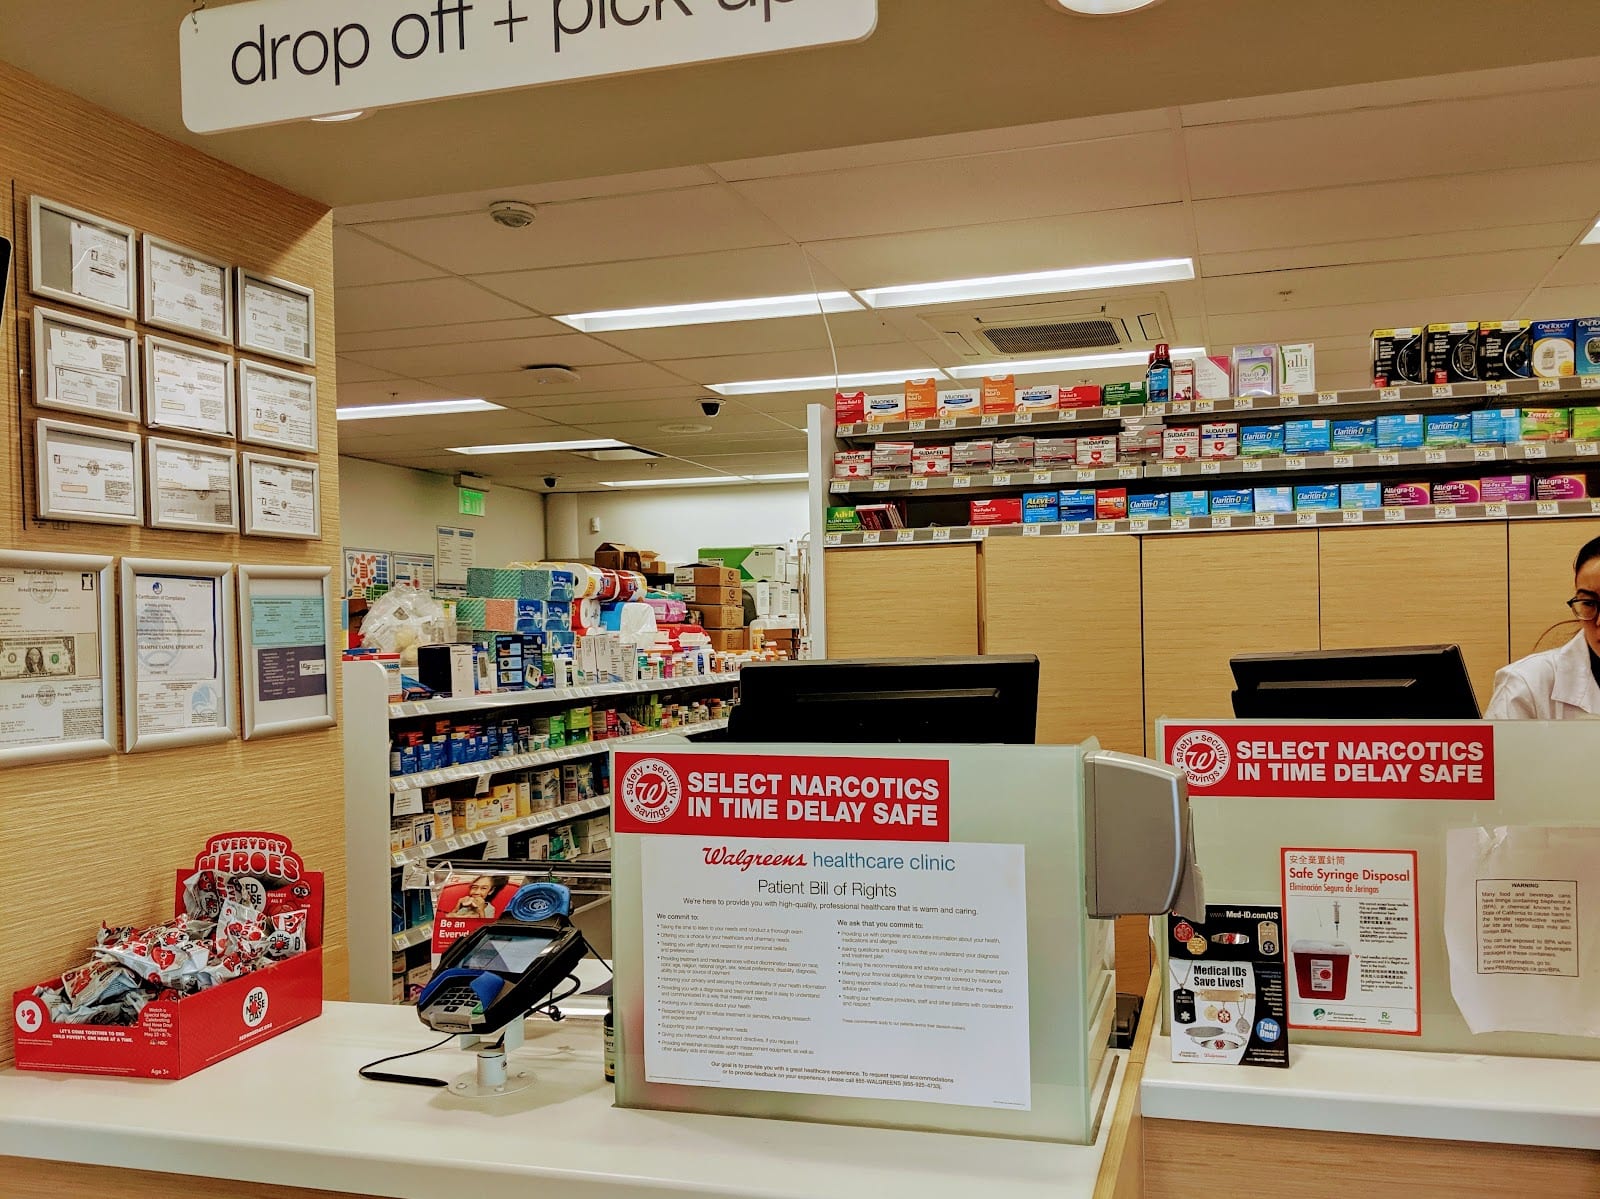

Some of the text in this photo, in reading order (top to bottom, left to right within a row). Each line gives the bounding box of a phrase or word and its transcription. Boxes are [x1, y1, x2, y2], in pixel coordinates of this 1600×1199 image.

[231, 23, 370, 86] drop
[391, 0, 473, 60] off
[1288, 354, 1308, 368] alli
[1433, 483, 1465, 491] Allegra-D
[1537, 477, 1569, 486] Allegra-D
[1384, 486, 1414, 494] Allegra-D
[1176, 737, 1193, 763] safety
[1201, 734, 1228, 765] security
[1236, 740, 1484, 762] SELECT NARCOTICS
[626, 766, 644, 796] safety
[652, 764, 679, 799] security
[1186, 770, 1220, 783] savings
[1237, 763, 1483, 784] IN TIME DELAY SAFE
[687, 771, 939, 801] SELECT NARCOTICS
[634, 804, 671, 819] savings
[688, 797, 938, 826] IN TIME DELAY SAFE
[211, 838, 287, 854] EVERYDAY
[199, 852, 300, 881] HEROES
[702, 846, 956, 872] Walgreens healthcare clinic
[1289, 867, 1410, 884] Safe Syringe Disposal
[758, 879, 897, 900] Patient Bill of Rights
[1289, 882, 1379, 895] Eliminación Segura de Jeringas
[683, 897, 701, 905] We're
[725, 899, 749, 907] provide
[779, 900, 818, 910] high-quality,
[819, 902, 859, 911] professional
[860, 903, 896, 911] healthcare
[940, 906, 953, 914] and
[954, 907, 978, 916] caring.
[440, 919, 452, 928] Be
[1193, 965, 1247, 977] Medical IDs
[1194, 976, 1244, 988] Save Lives!
[249, 991, 263, 1003] RED
[21, 1009, 36, 1025] $2
[248, 1010, 263, 1023] DAY
[1260, 1021, 1278, 1031] Take
[151, 1068, 161, 1076] Age
